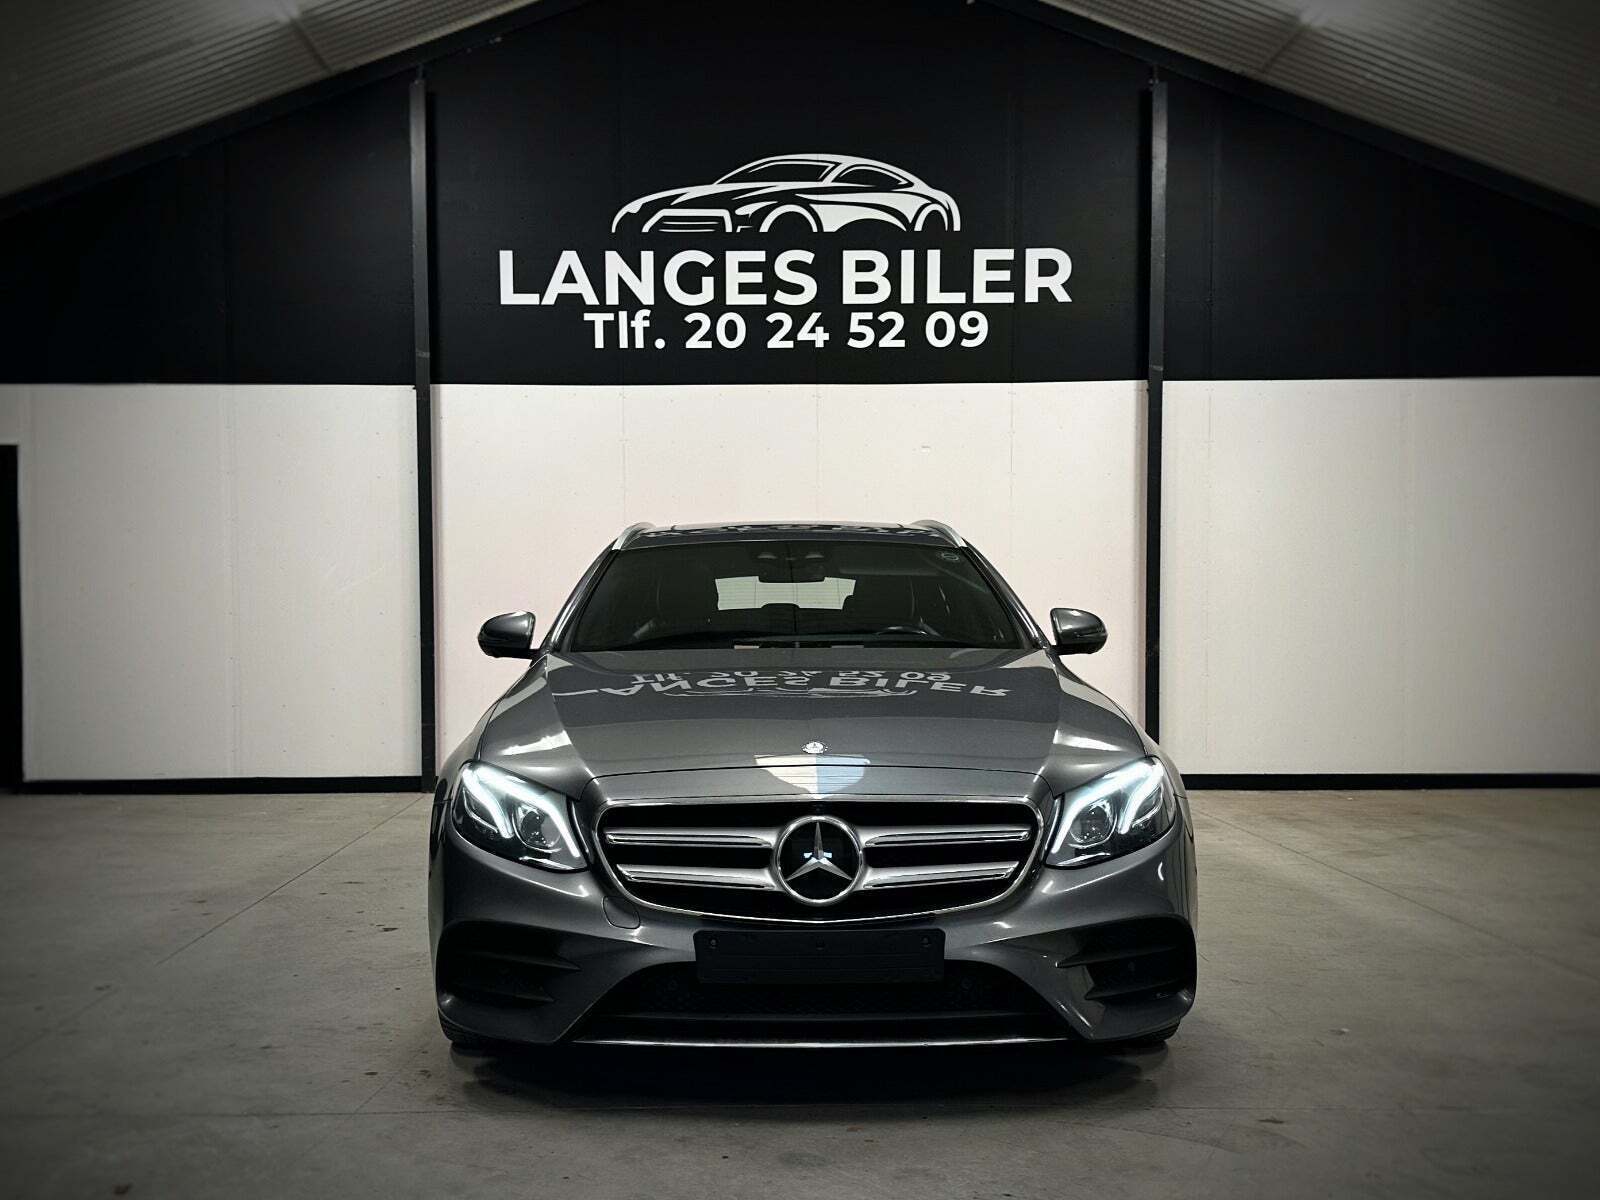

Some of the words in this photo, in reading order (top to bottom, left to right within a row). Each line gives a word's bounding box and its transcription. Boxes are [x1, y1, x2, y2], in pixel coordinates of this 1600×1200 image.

[499, 249, 818, 306] LANGES
[841, 247, 1073, 305] BILER
[583, 309, 665, 349] Tlf.
[684, 311, 747, 349] 20
[765, 311, 829, 348] 24
[847, 311, 905, 348] 52
[924, 310, 989, 348] 09
